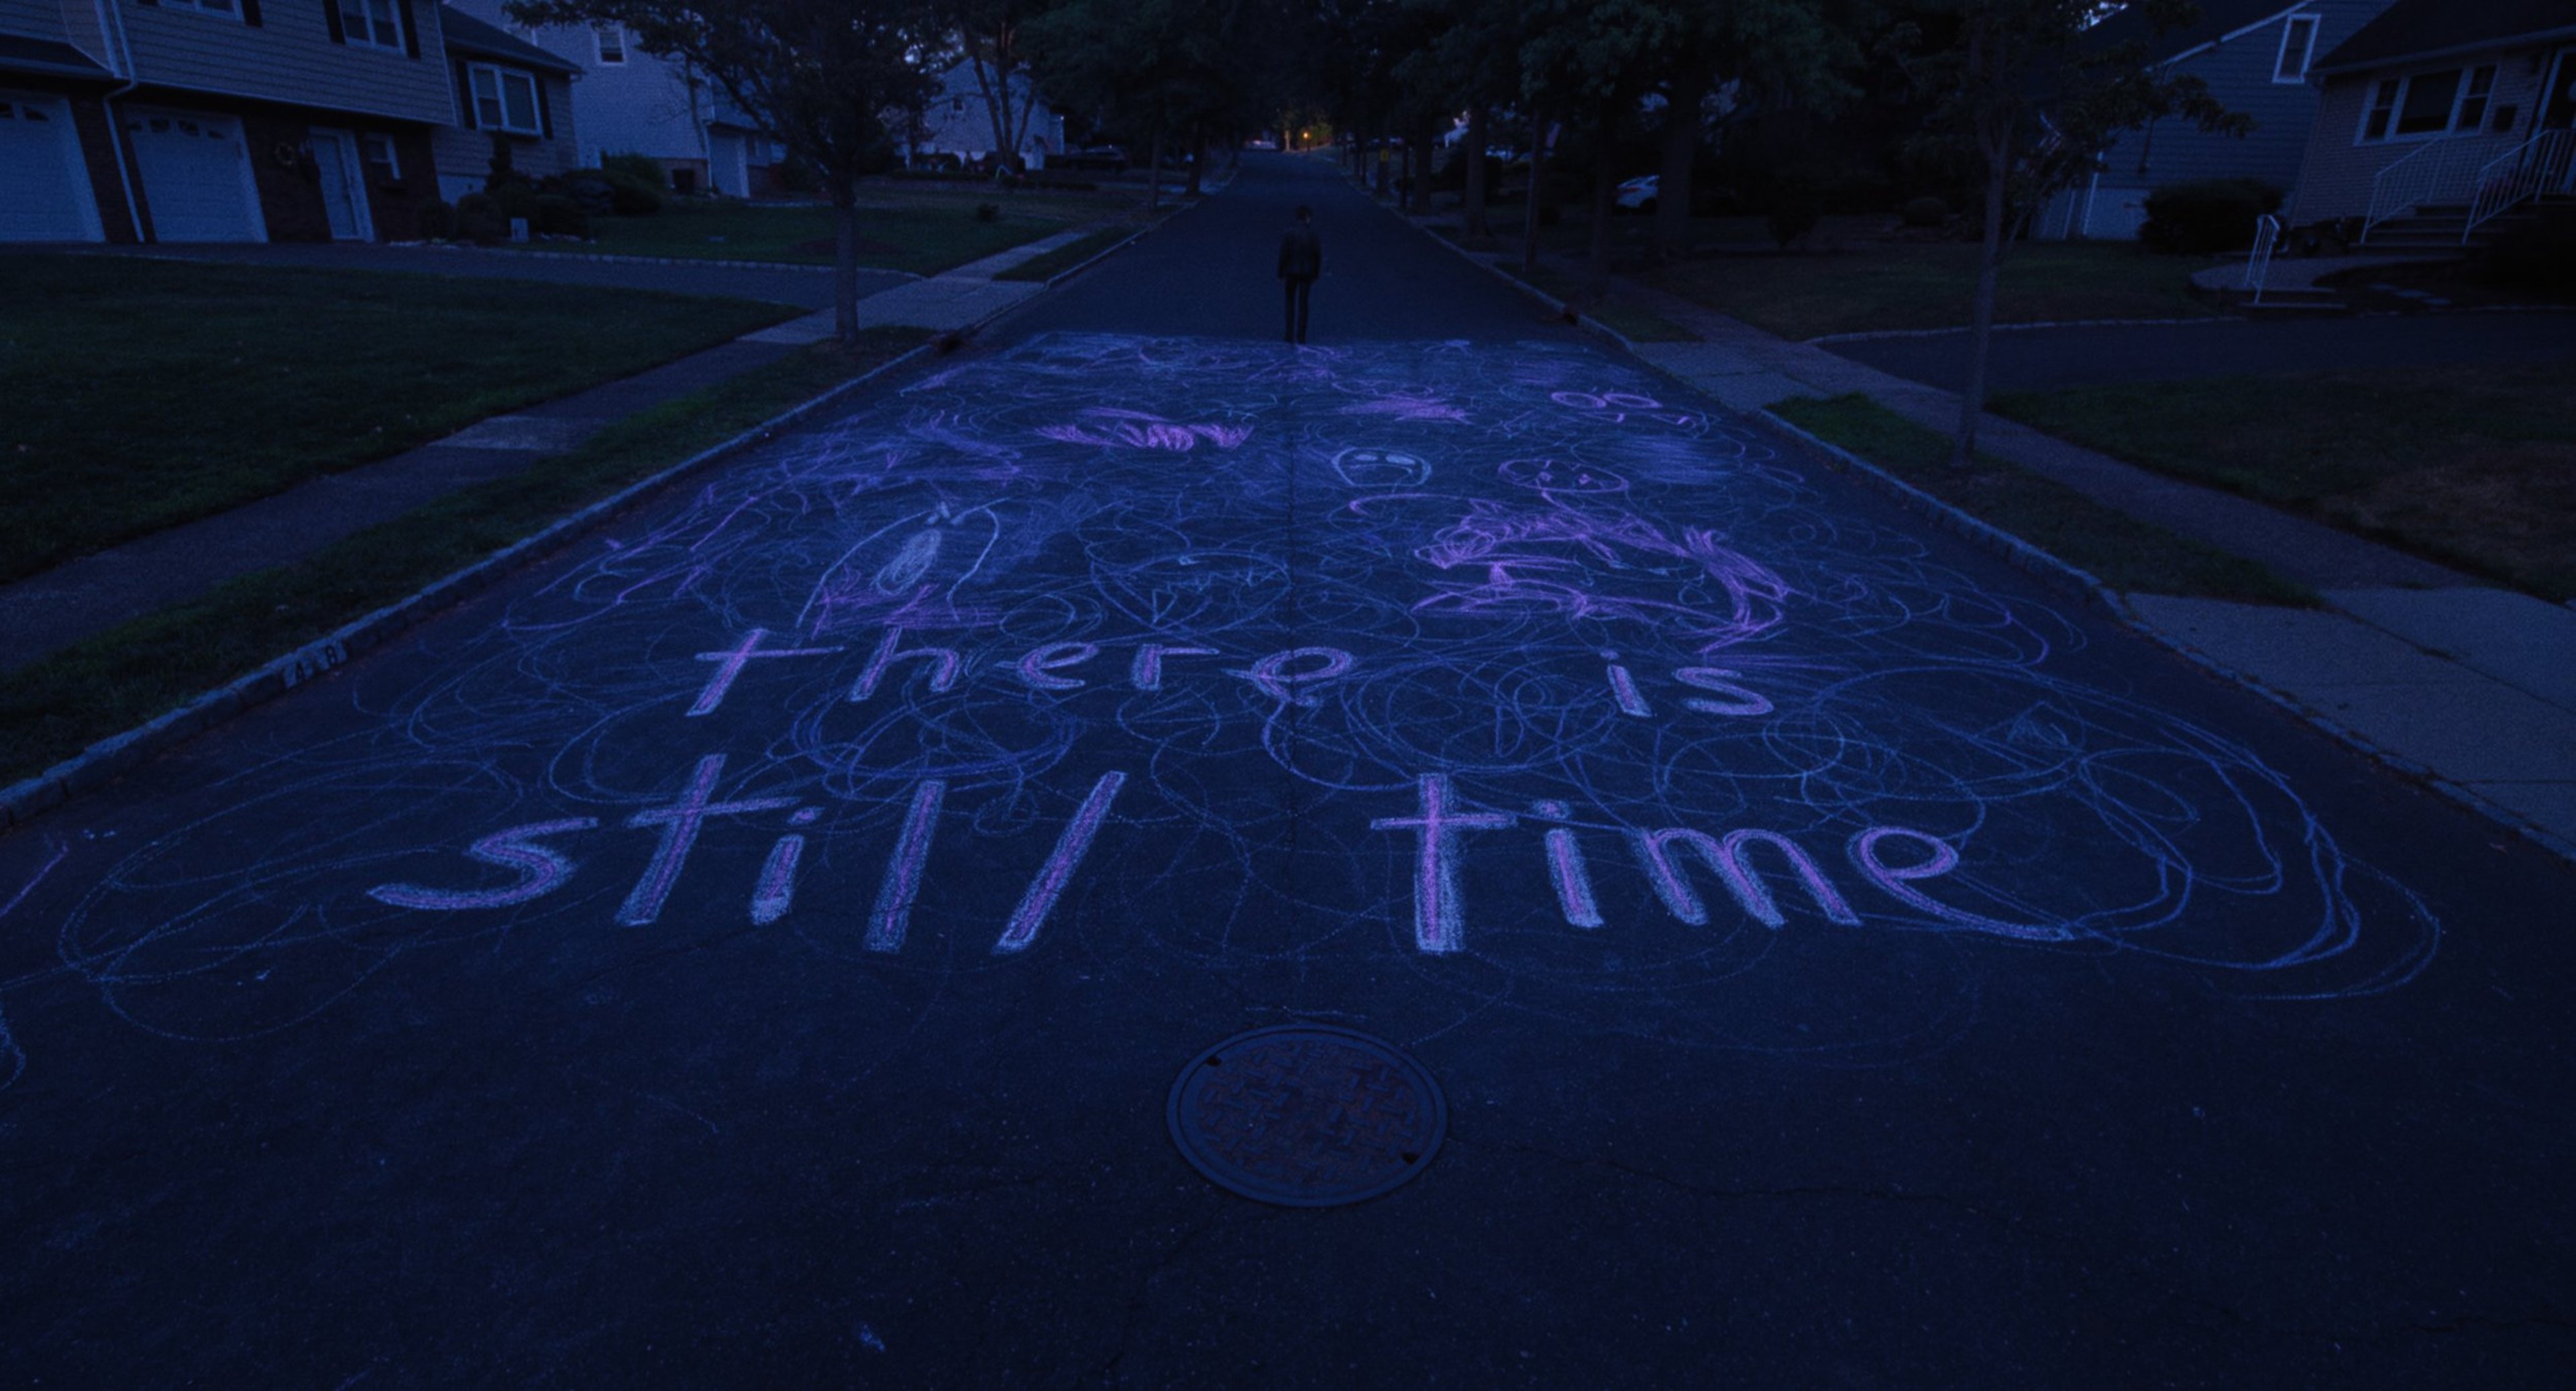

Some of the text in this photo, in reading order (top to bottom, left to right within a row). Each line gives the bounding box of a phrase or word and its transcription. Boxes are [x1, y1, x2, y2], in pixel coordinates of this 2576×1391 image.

[686, 627, 1775, 717] there is
[366, 753, 2077, 954] still time
